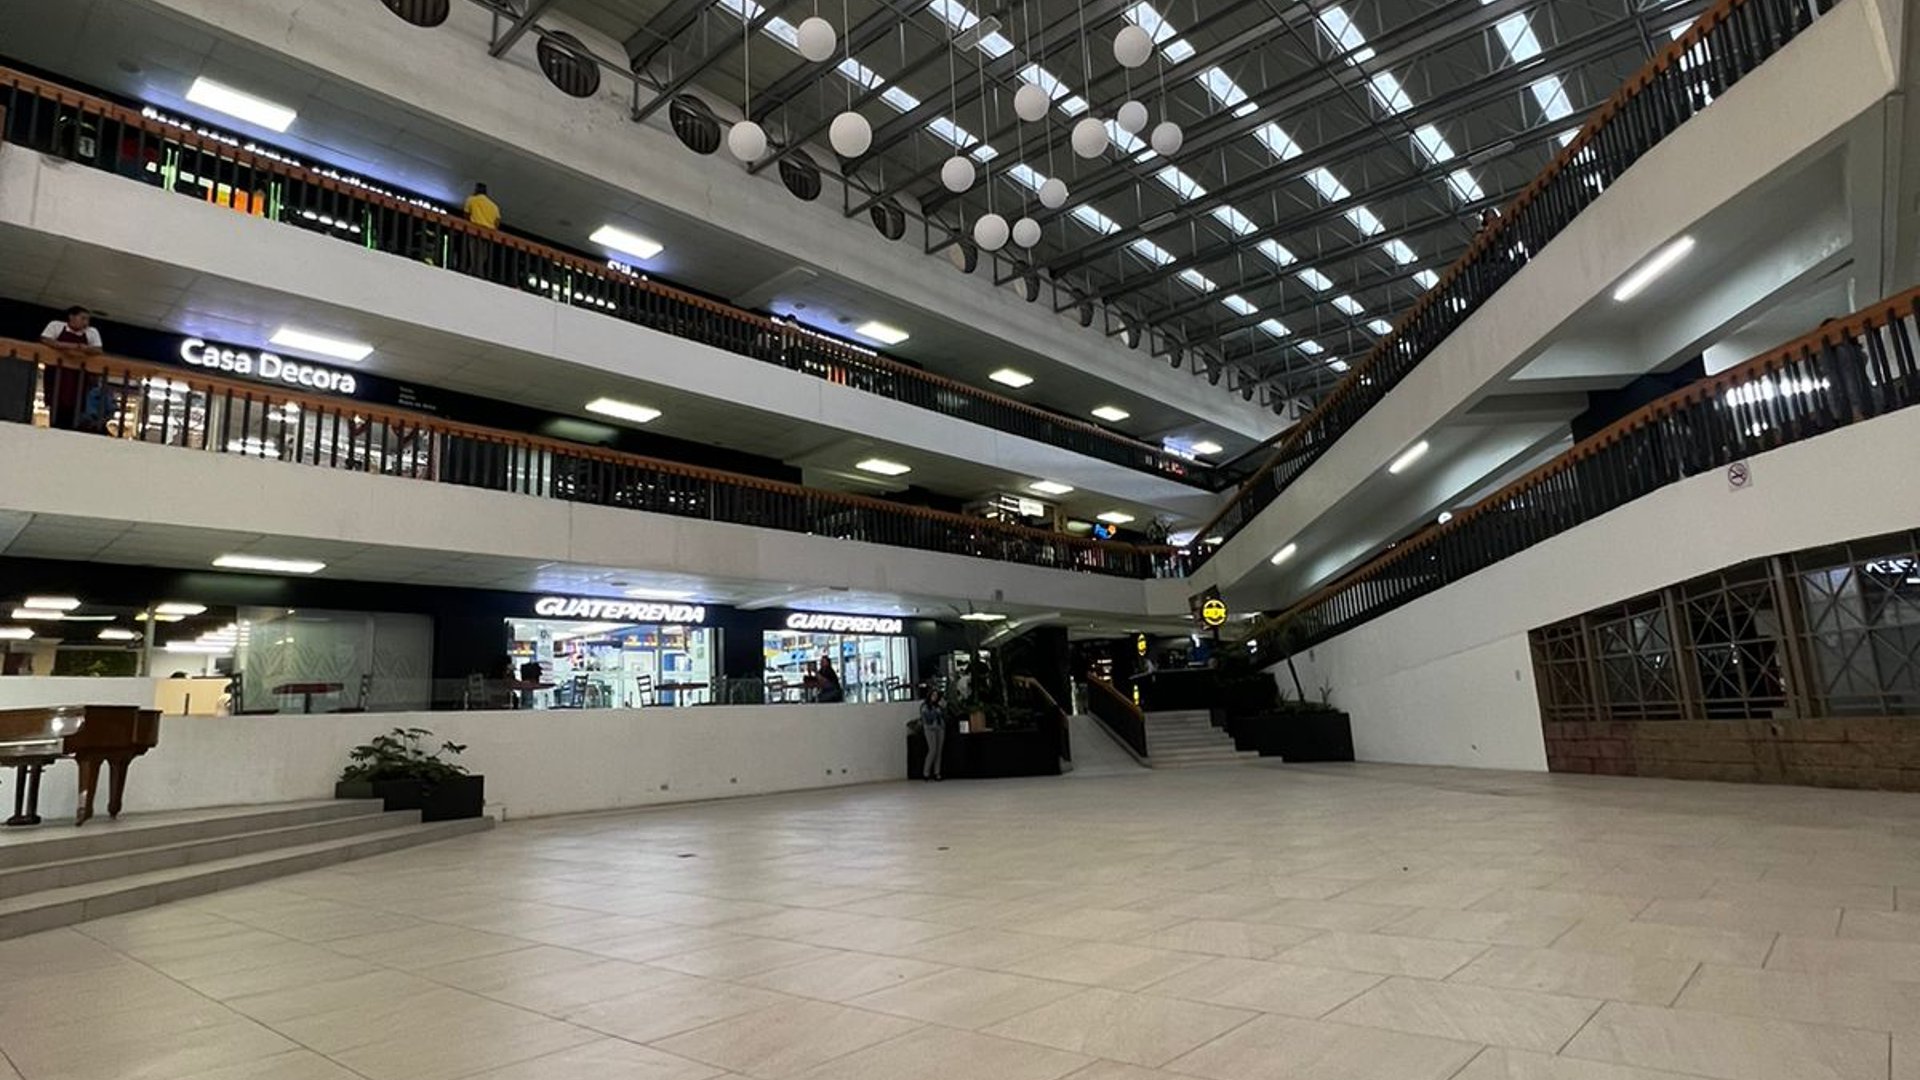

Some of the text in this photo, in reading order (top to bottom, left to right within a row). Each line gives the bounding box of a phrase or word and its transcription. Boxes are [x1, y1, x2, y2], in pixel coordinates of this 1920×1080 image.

[180, 338, 357, 394] Casa Decora
[535, 596, 706, 623] GUATEPRENDA
[786, 612, 903, 633] GUATEPRENDA
